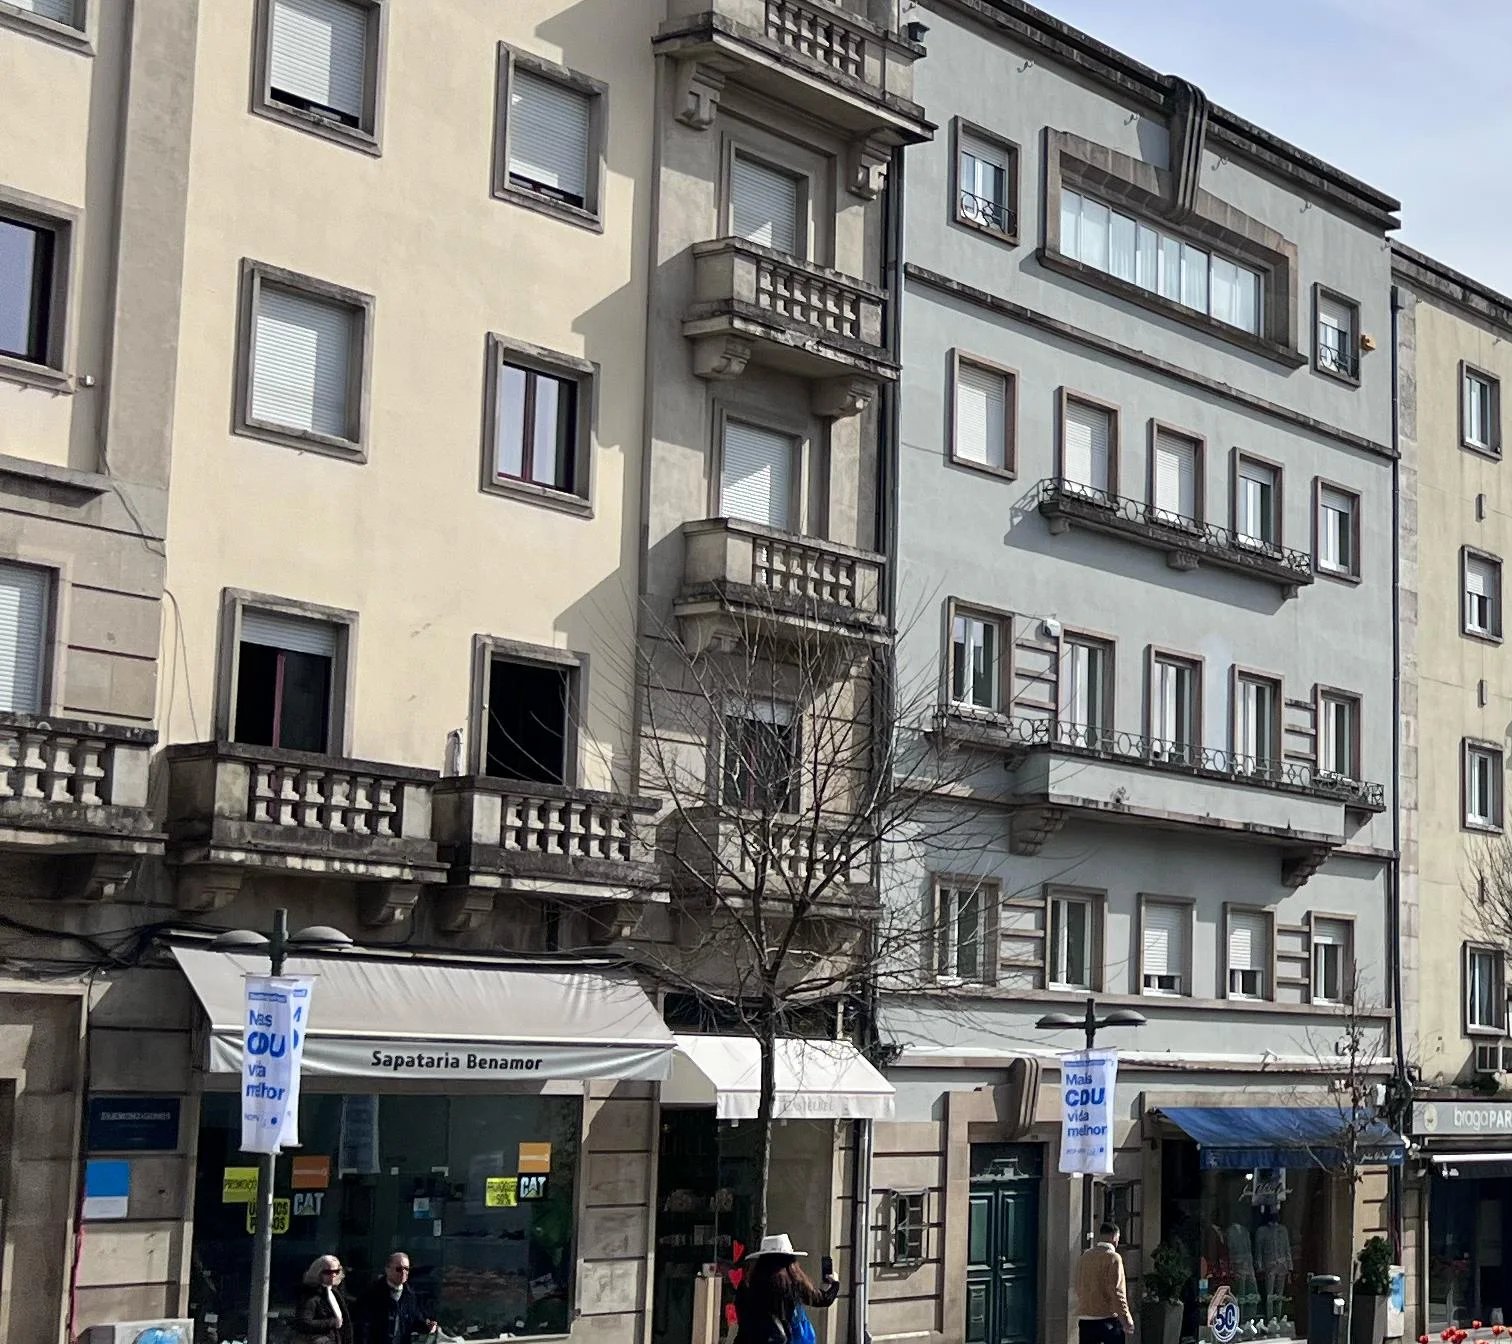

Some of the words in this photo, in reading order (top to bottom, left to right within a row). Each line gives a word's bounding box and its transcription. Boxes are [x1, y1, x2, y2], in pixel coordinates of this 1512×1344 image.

[371, 1050, 460, 1070] Sapataria
[466, 1053, 543, 1070] Benamor
[1065, 1088, 1105, 1107] CDU
[520, 1176, 546, 1198] CAT
[293, 1192, 325, 1216] CAT
